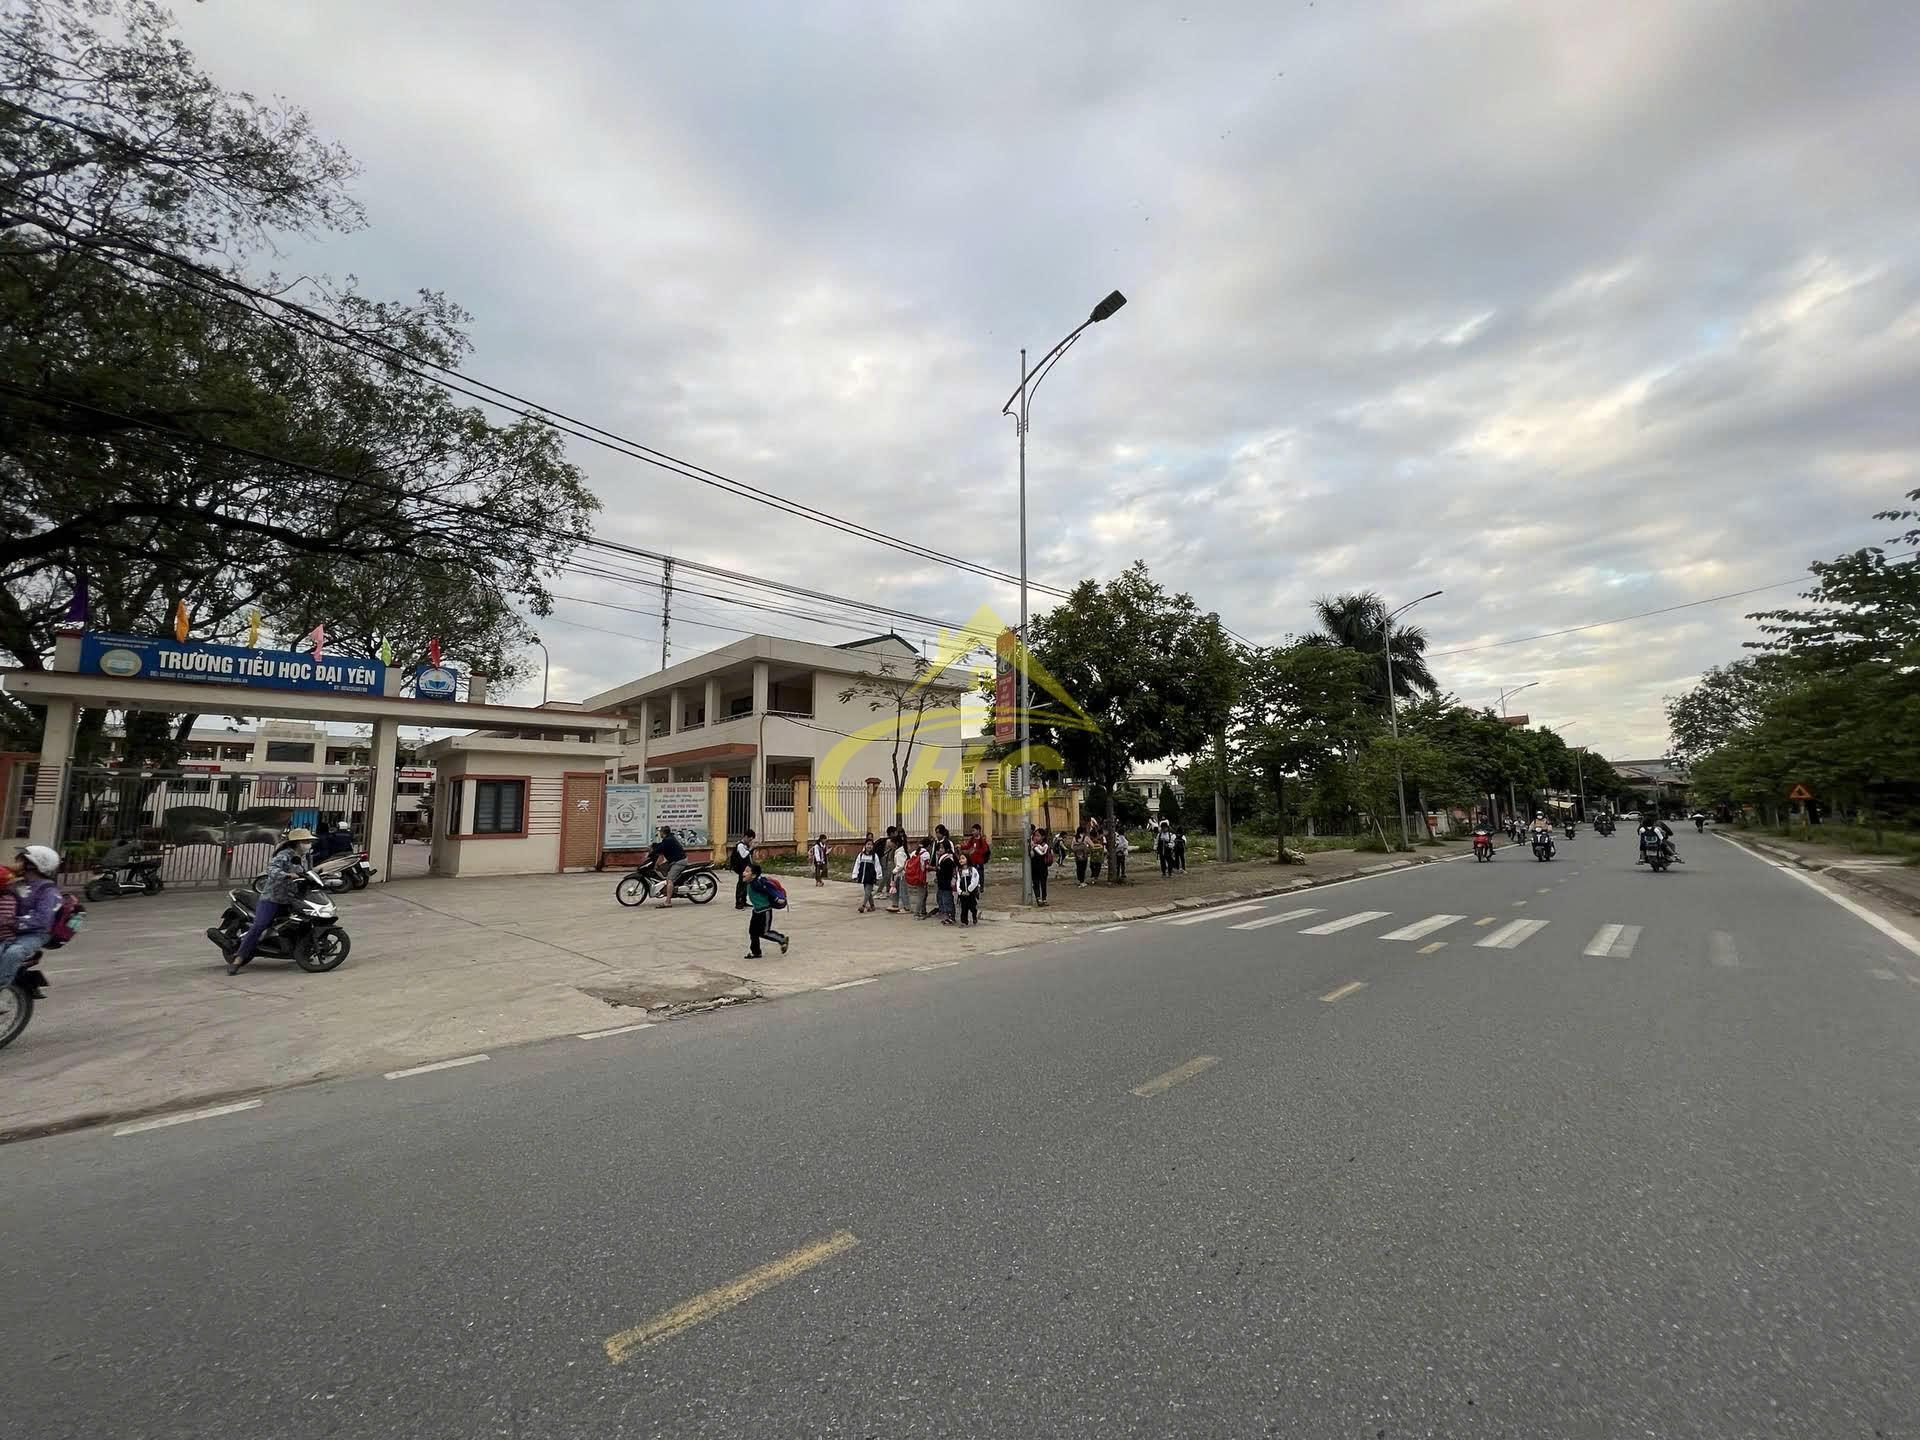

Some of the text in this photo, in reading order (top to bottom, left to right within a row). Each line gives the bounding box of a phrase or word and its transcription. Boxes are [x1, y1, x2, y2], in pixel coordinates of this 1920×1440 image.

[158, 649, 234, 674] TRƯỜNG
[238, 651, 275, 677] TIỂU
[278, 661, 311, 683] HỌC
[315, 665, 342, 685] ĐẠI
[347, 666, 376, 686] YÊN
